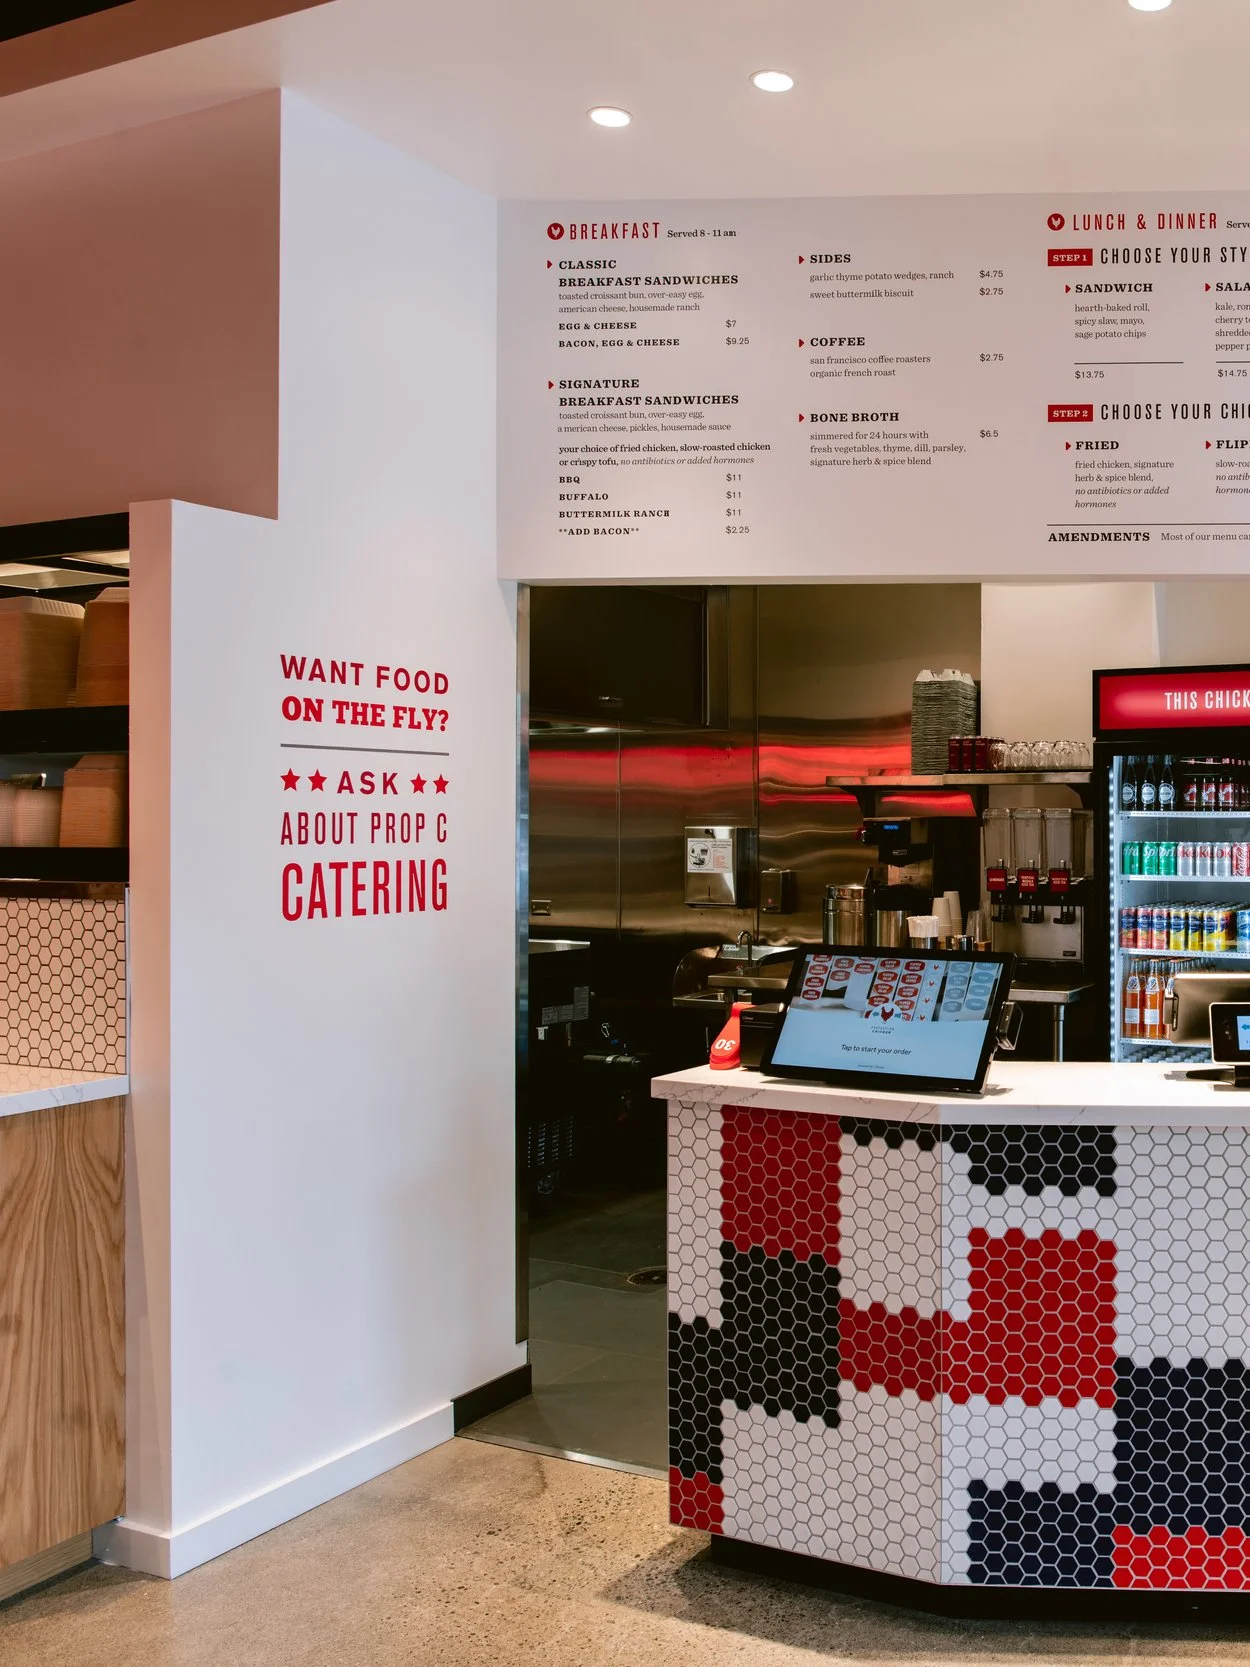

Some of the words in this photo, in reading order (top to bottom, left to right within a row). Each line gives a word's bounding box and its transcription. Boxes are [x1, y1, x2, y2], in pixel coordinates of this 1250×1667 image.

[1074, 214, 1124, 230] LUNCH
[1137, 214, 1146, 229] &
[1158, 213, 1216, 229] DINNER
[570, 222, 659, 240] BREAKFAST
[668, 229, 698, 238] Served
[810, 254, 850, 263] SIDES
[1053, 254, 1080, 262] STEP
[1101, 248, 1161, 264] CHOOSE
[1171, 247, 1210, 263] YOUR
[559, 260, 616, 270] CLASSIC
[979, 270, 1003, 278] $4.75
[559, 277, 641, 287] BREAKFAST
[645, 275, 738, 285] SANDWICHES
[980, 287, 1003, 296] $2.75
[1076, 284, 1152, 293] SANDWICH
[559, 305, 597, 313] american
[598, 304, 628, 312] cheese,
[629, 303, 675, 312] housemade
[677, 303, 700, 311] ranch
[726, 320, 736, 328] $7
[559, 340, 598, 348] BACON,
[726, 337, 749, 345] $9.25
[810, 337, 865, 346] COFFEE
[827, 356, 866, 364] francisco
[868, 355, 894, 363] coffee
[980, 353, 1004, 362] $2.75
[1075, 370, 1104, 379] $13.75
[1218, 369, 1247, 378] $14.75
[559, 379, 639, 389] SIGNATURE
[560, 397, 641, 406] BREAKFAST
[645, 395, 738, 405] SANDWICHES
[1101, 404, 1161, 420] CHOOSE
[1171, 404, 1210, 419] YOUR
[810, 414, 848, 422] BONE
[852, 413, 899, 422] BROTH
[980, 429, 998, 438] $6.5
[1076, 441, 1119, 450] FRIED
[560, 476, 580, 484] BBQ
[726, 473, 741, 482] $11
[726, 491, 741, 499] $11
[726, 508, 740, 516] $11
[1048, 532, 1150, 541] AMENDMENTS
[280, 654, 364, 686] WANT
[377, 666, 448, 694] FOOD
[1165, 692, 1197, 710] THIS
[282, 696, 324, 722] ON
[332, 700, 385, 727] THE
[393, 706, 448, 731] FLY?
[337, 771, 398, 794] ASK
[281, 812, 358, 845] ABOUT
[371, 813, 425, 843] PROP
[437, 813, 446, 842] C
[282, 859, 447, 921] CATERING
[715, 1039, 735, 1050] 30
[842, 1044, 852, 1052] Tap
